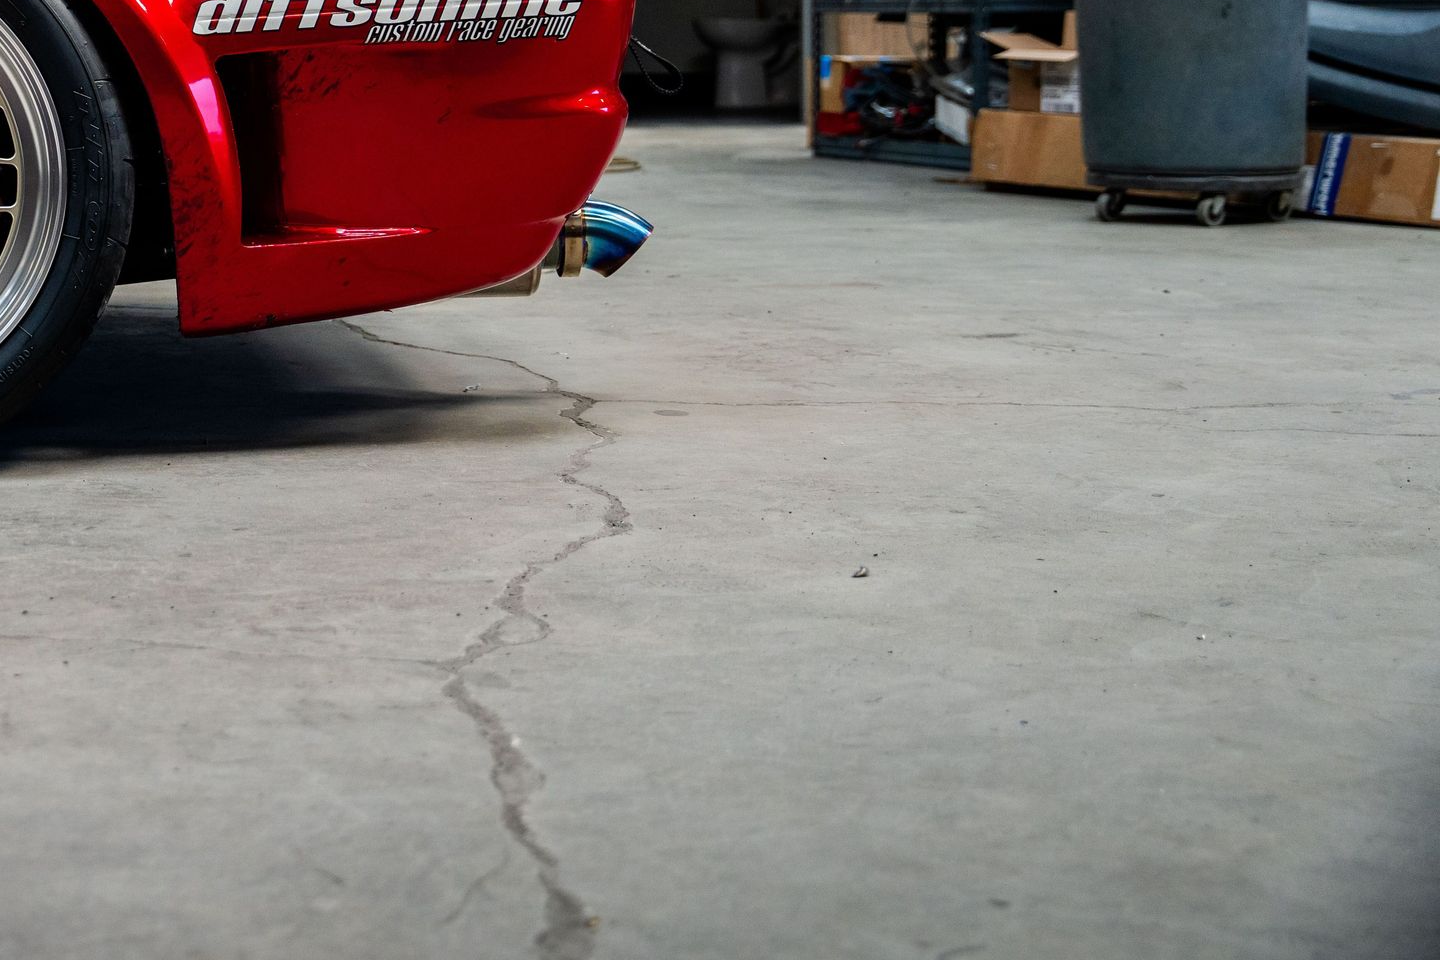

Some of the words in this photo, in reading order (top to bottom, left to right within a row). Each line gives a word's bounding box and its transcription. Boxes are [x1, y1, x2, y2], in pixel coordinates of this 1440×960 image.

[364, 19, 445, 44] custom
[445, 17, 496, 43] race
[497, 13, 576, 44] gearing
